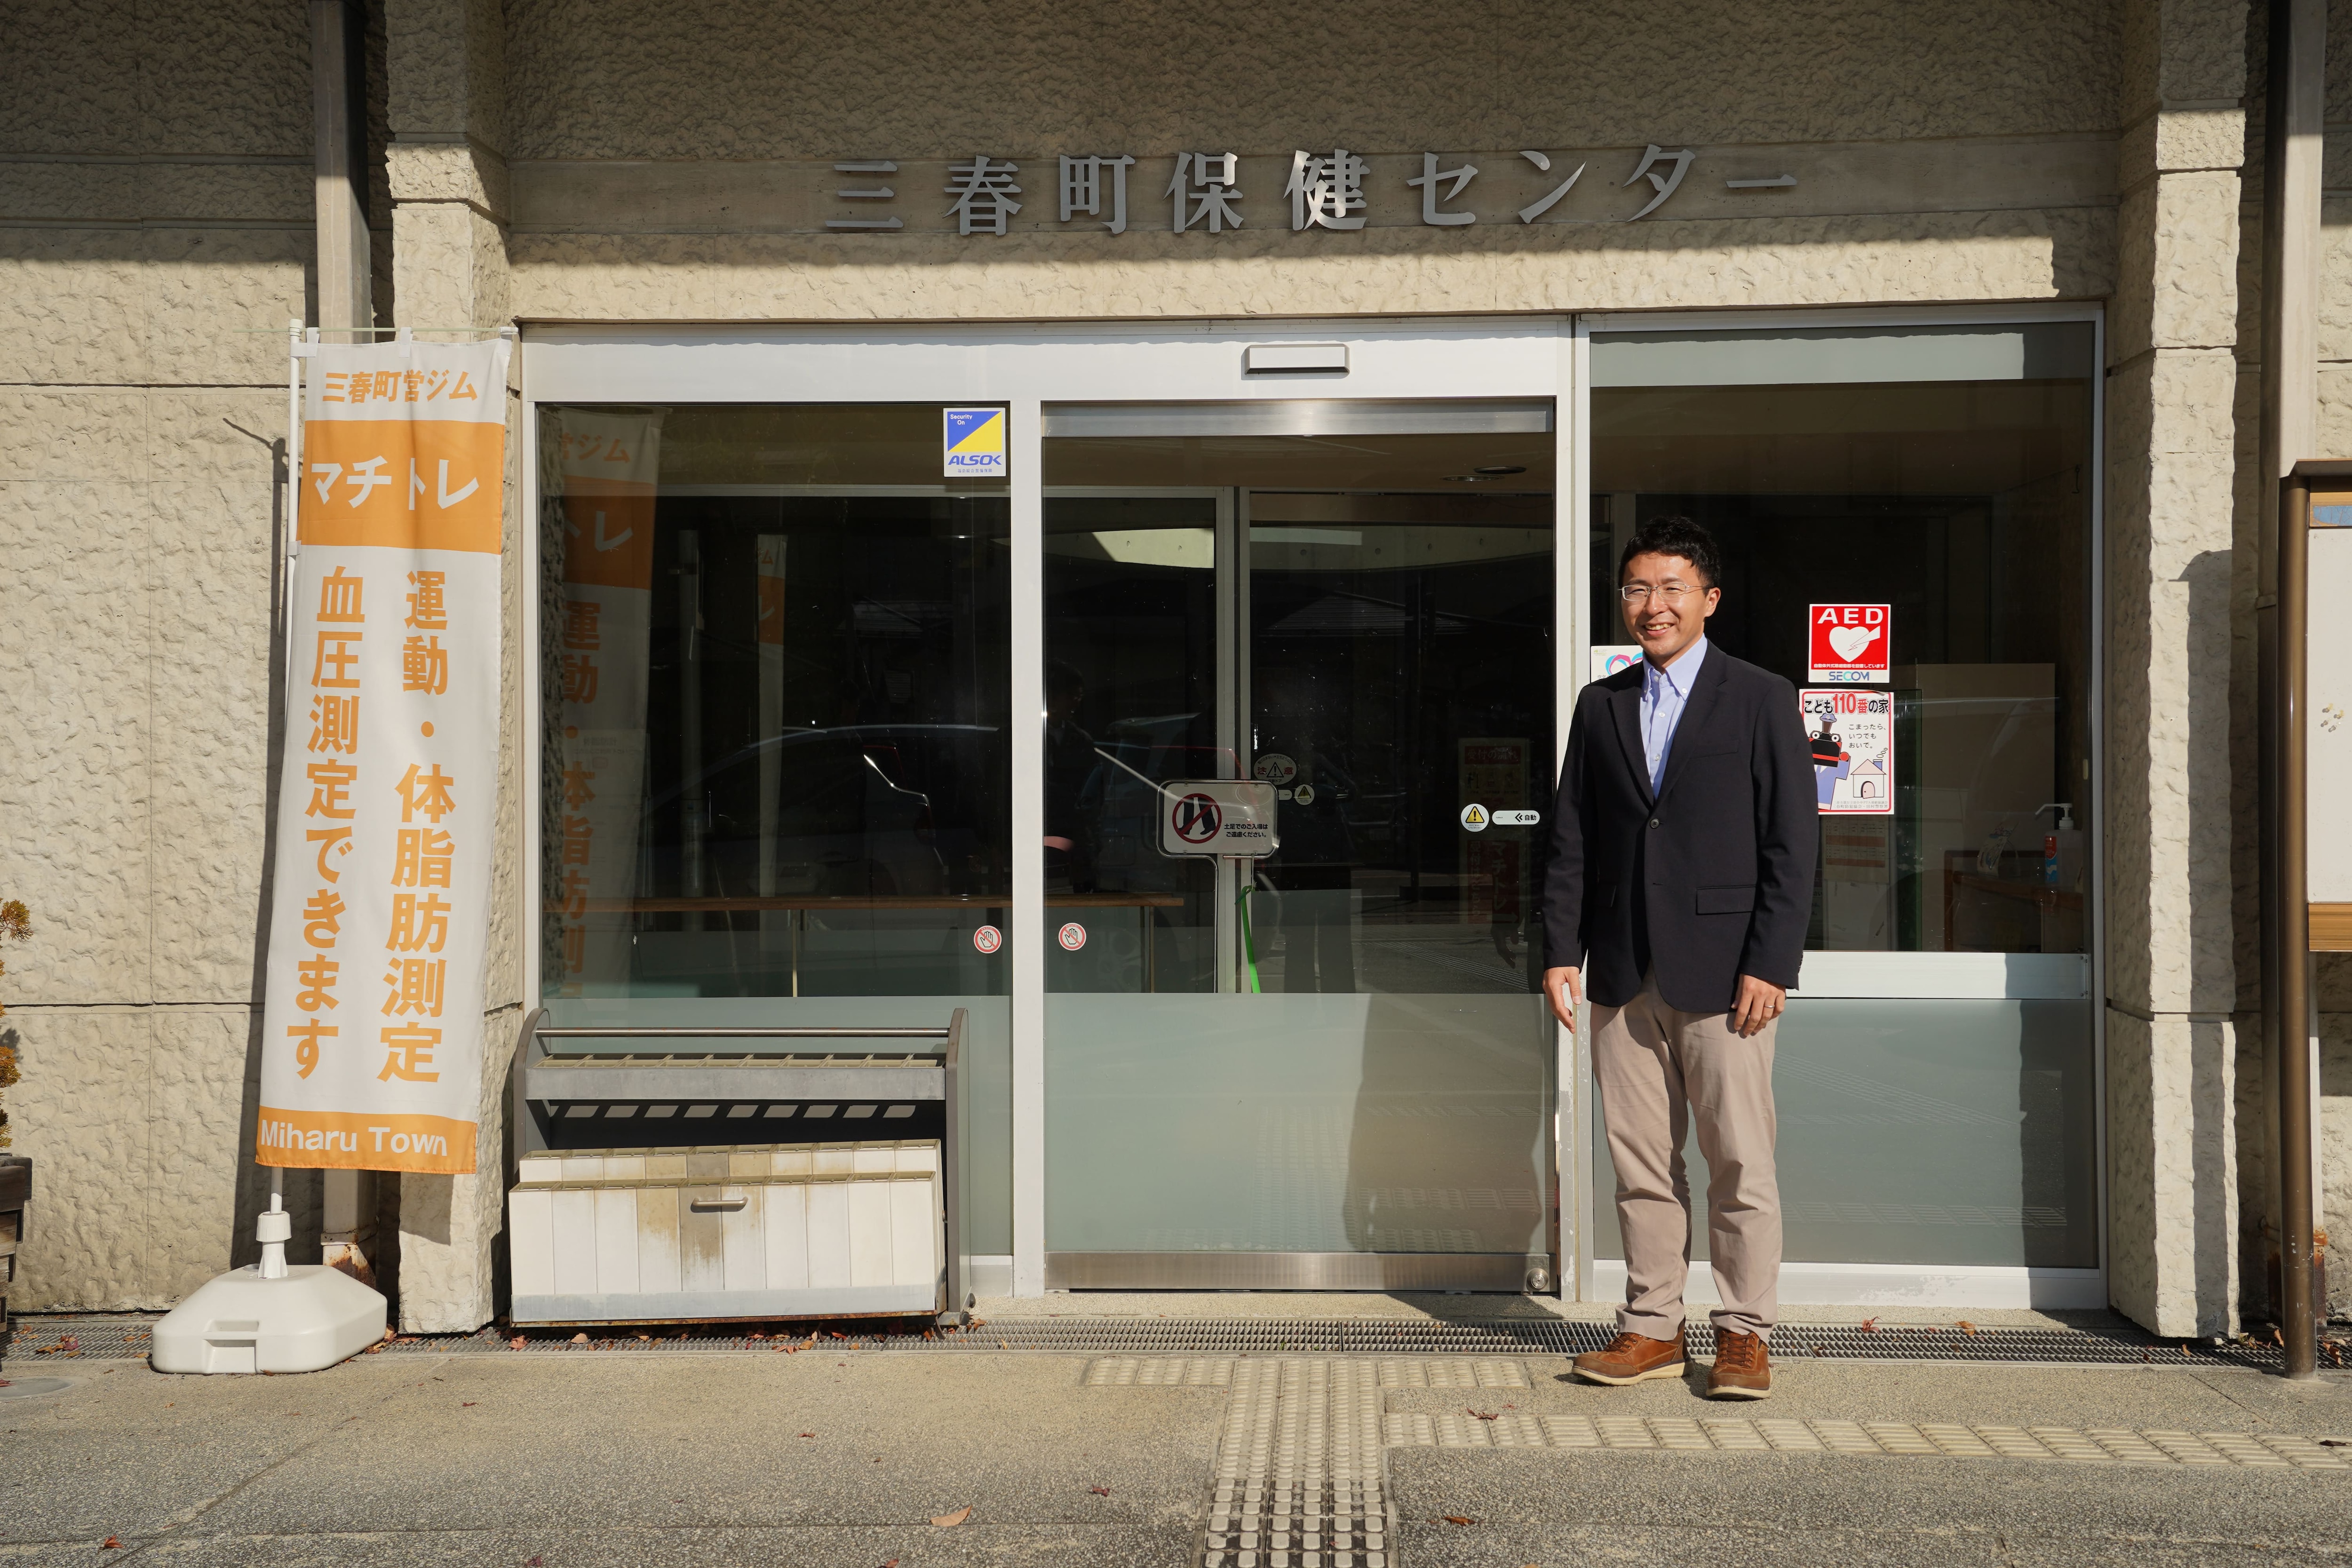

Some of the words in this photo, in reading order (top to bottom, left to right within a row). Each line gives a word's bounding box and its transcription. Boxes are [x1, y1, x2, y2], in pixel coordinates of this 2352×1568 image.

[824, 143, 1799, 236] 三春町保健センター
[322, 369, 478, 404] 三春町営ジム
[948, 454, 1002, 466] ALSOK
[311, 454, 479, 511] マチトレ
[1817, 608, 1883, 624] AED
[1829, 671, 1869, 681] SECOM
[1804, 692, 1890, 714] こども110番の家
[286, 565, 366, 1080] 血圧測定できます
[376, 570, 456, 1083] 運動・体脂肪測定
[1492, 842, 1507, 911] マチトレ
[261, 1120, 358, 1152] Miharu
[368, 1126, 447, 1157] Town
